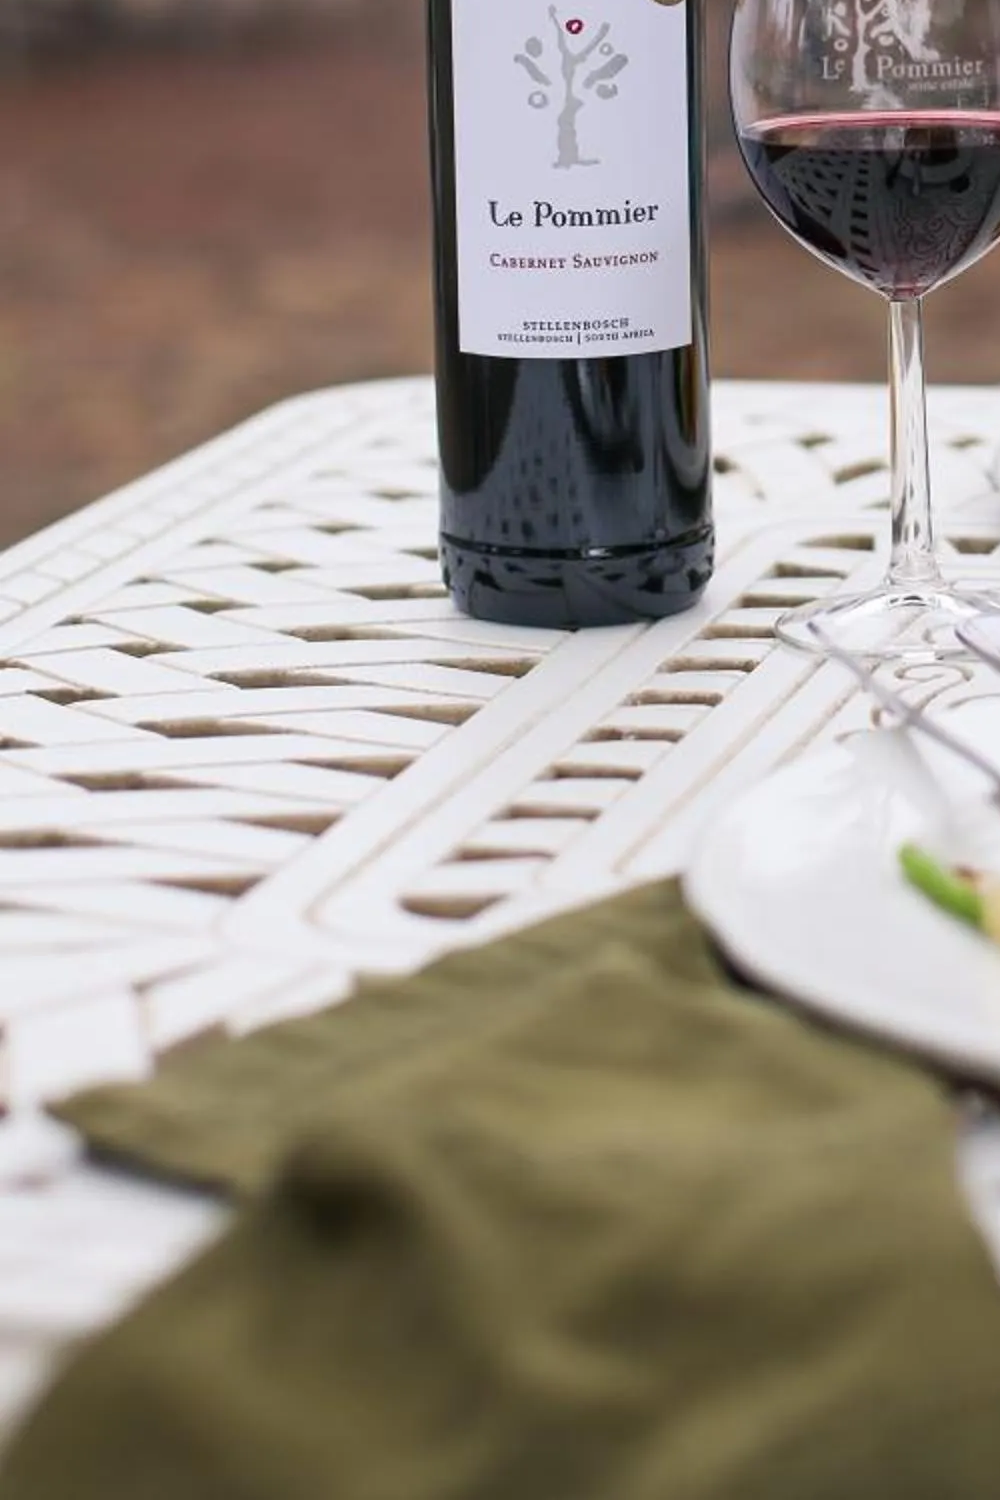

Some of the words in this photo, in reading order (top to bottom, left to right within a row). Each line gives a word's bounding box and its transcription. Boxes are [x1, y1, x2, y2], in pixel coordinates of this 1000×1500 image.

[822, 54, 846, 80] Le
[876, 54, 984, 80] Pommier
[487, 200, 523, 228] Le
[533, 199, 660, 228] Pommier
[489, 252, 567, 270] CABERNET
[572, 250, 660, 270] SAUVIGNON
[522, 317, 630, 332] STELLENBOSCH
[497, 332, 573, 344] STELLENBOSCH
